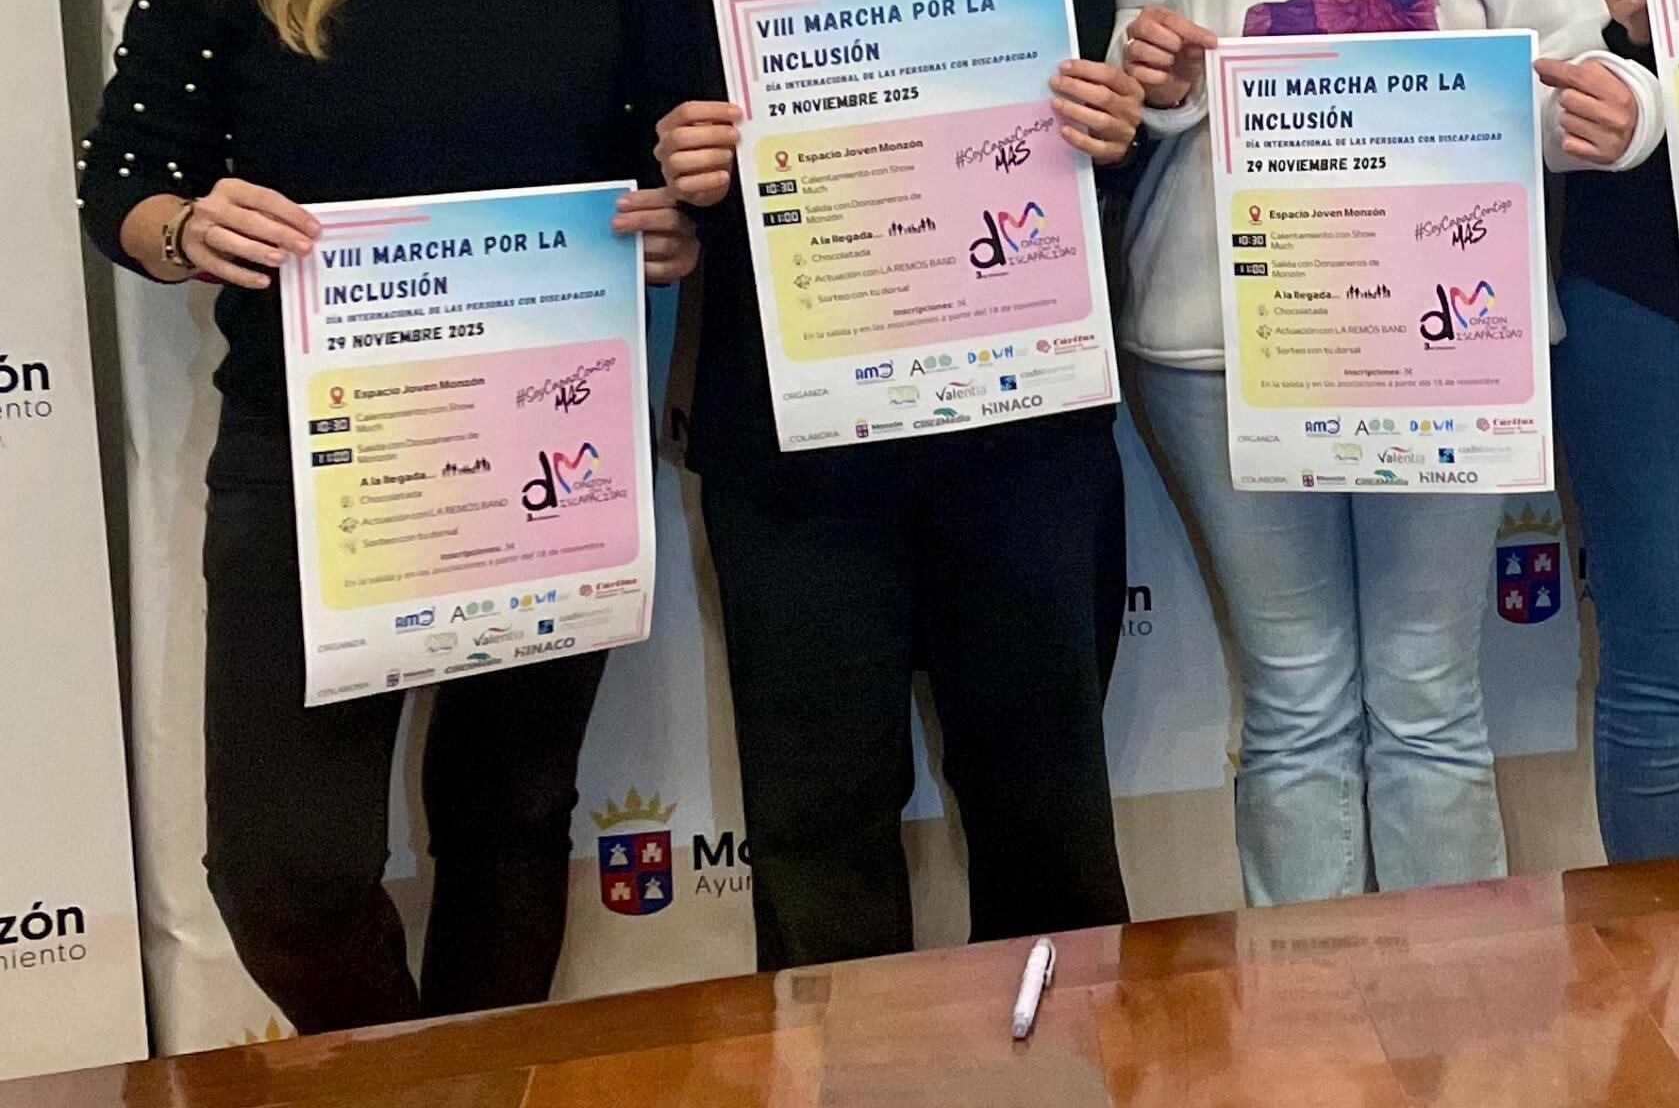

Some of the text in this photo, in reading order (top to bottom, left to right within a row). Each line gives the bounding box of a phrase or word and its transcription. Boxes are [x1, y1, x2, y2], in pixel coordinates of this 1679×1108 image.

[756, 17, 794, 38] VIII
[805, 5, 902, 33] MARCHA
[762, 40, 880, 73] INCLUSIÓN
[785, 75, 859, 89] INTERNACIONAL
[863, 72, 875, 80] DE
[878, 69, 896, 78] LAS
[900, 62, 947, 76] PERSONAS
[951, 59, 969, 68] CON
[971, 51, 1038, 66] DISCAPACIDAD
[1243, 72, 1466, 97] VIII MARCHA POR LA
[769, 87, 919, 116] 29 NOVIEMBRE 2025
[1245, 106, 1353, 131] INCLUSIÓN
[797, 139, 923, 164] Espacio Joven Monzón
[1263, 139, 1332, 148] INTERNACIONAL
[1350, 137, 1366, 146] LAS
[1370, 136, 1415, 145] PERSONAS
[1418, 135, 1435, 143] CON
[1439, 133, 1502, 142] DISCAPACIDAD
[1246, 156, 1386, 173] 29 NOVIEMBRE 2025
[1269, 206, 1386, 220] Espacio Joven Monzón
[322, 230, 567, 268] VIII MARCHA POR LA
[325, 273, 448, 305] INCLUSIÓN
[328, 323, 484, 350] 29 NOVIEMBRE 2025
